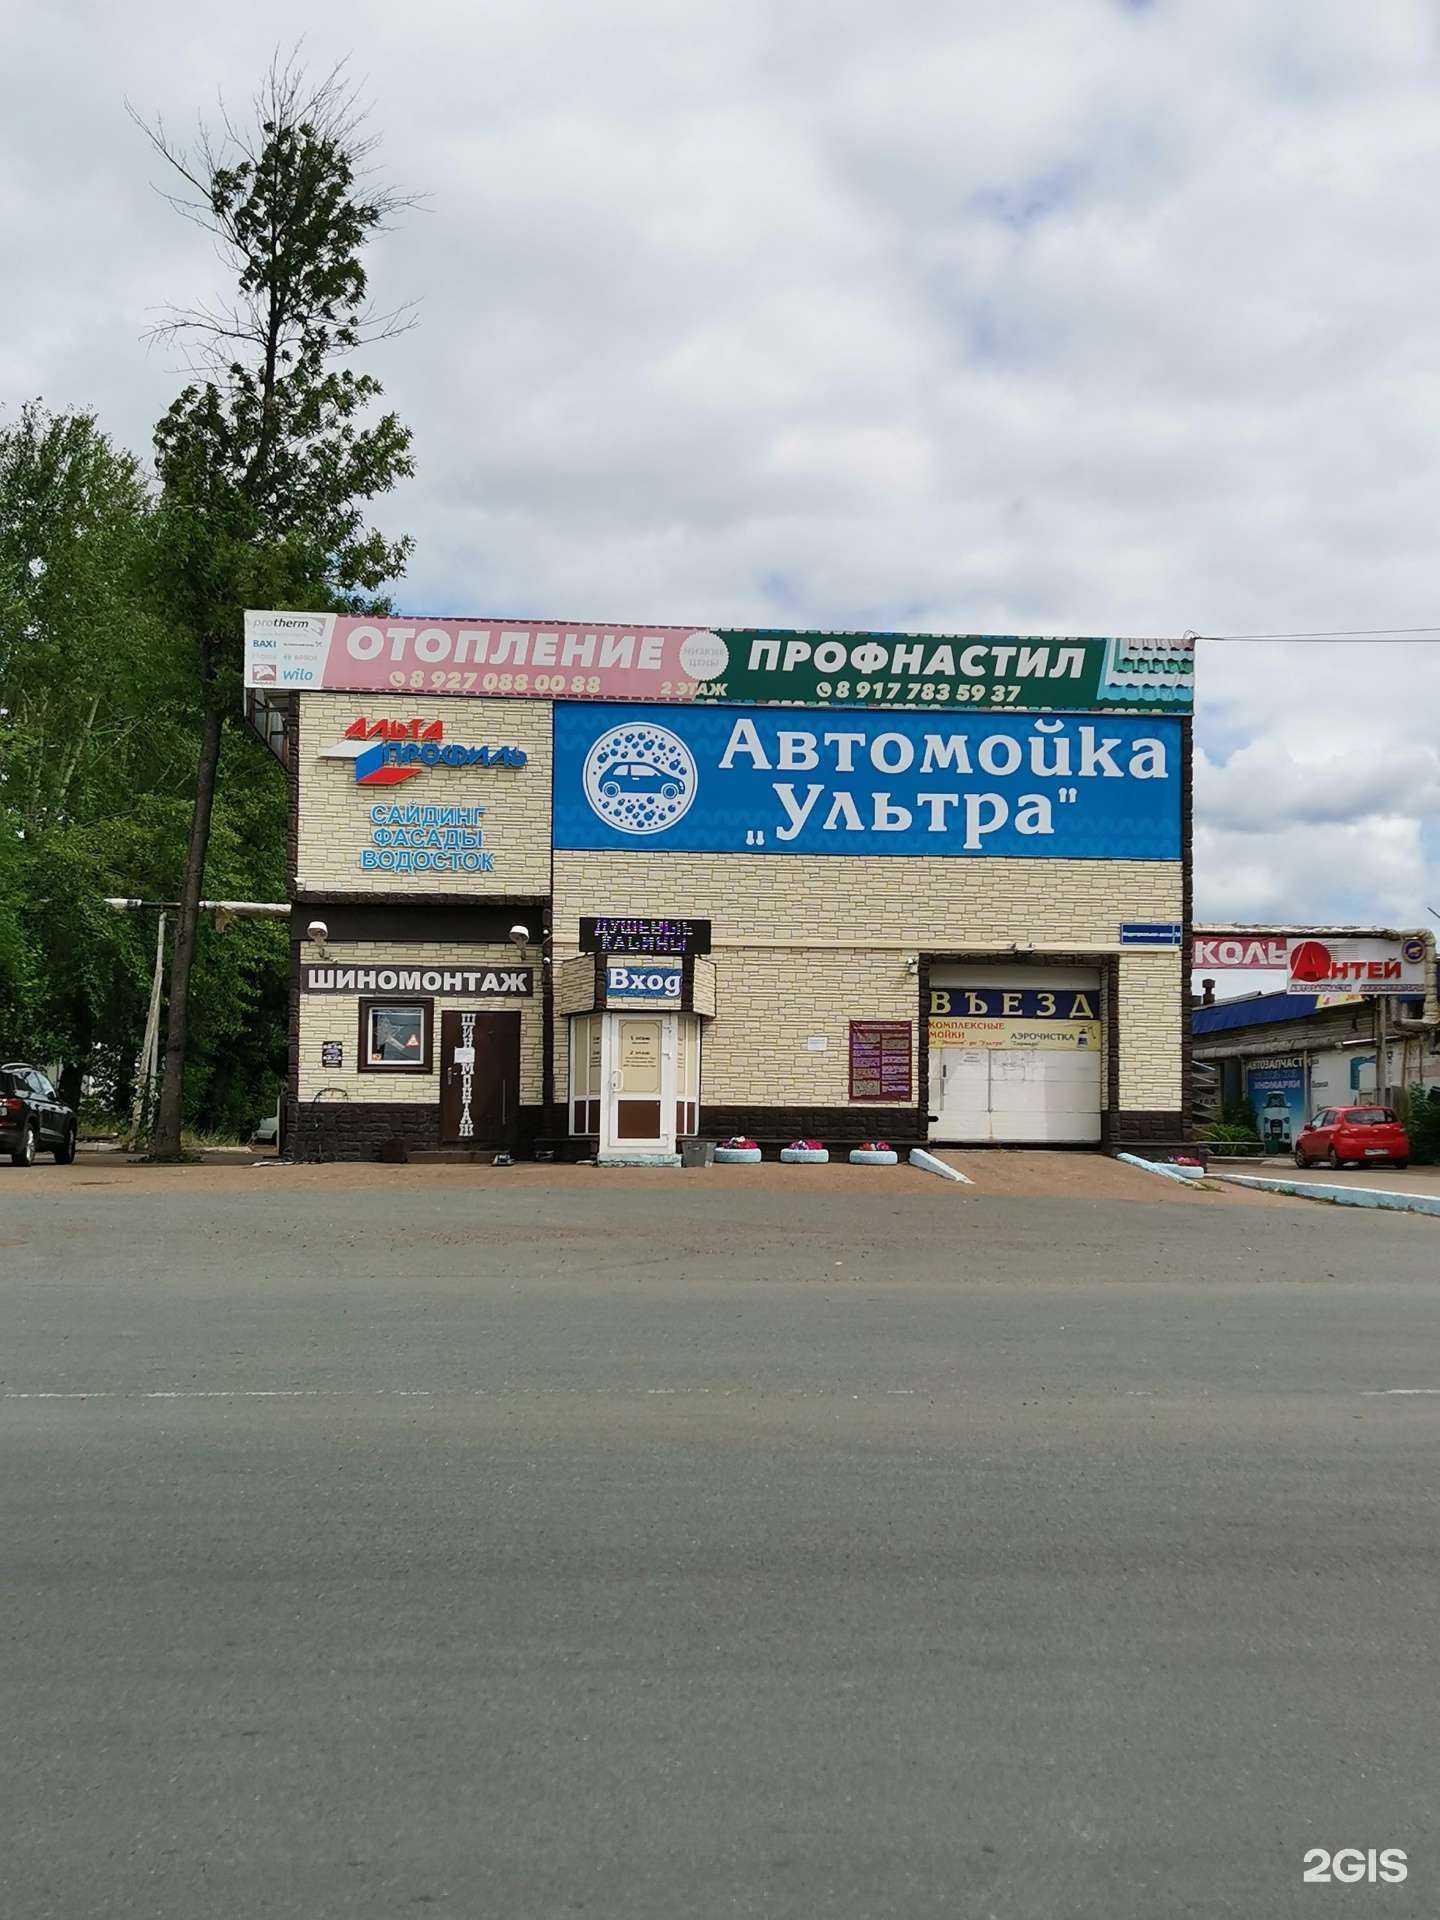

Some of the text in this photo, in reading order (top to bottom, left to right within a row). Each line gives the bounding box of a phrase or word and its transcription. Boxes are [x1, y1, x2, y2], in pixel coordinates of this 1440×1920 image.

[253, 640, 277, 649] BAXI
[346, 625, 665, 670] ОТОПЛЕНИЕ
[747, 639, 1086, 679] ПРОФНАСТИЛ
[283, 667, 313, 681] wilo
[409, 670, 425, 688] 8
[431, 670, 478, 689] 927
[534, 674, 566, 692] 00
[570, 676, 601, 693] 88
[660, 681, 729, 696] 2 ЭТАЖ
[835, 681, 1021, 702] 8 917 783 59 37
[343, 716, 444, 742] АЛЬТА
[382, 740, 528, 769] ПРОФИЛЬ
[718, 717, 1169, 779] Автомойка
[370, 801, 487, 829] САЙДИНГ
[373, 828, 485, 850] ФАСАДЫ
[360, 849, 496, 873] ВОДОСТОК
[308, 969, 528, 992] ШИНОМОНТАЖ
[608, 967, 682, 997] Вход
[929, 991, 1094, 1019] ВЪЕЗД
[928, 1020, 1005, 1031] КОМПЛЕКСНЫЕ
[928, 1029, 966, 1039] МОЙКИ
[1010, 1032, 1076, 1042] АЭРОЧИСТКА
[459, 1013, 477, 1137] ШИНМОНТАЖ
